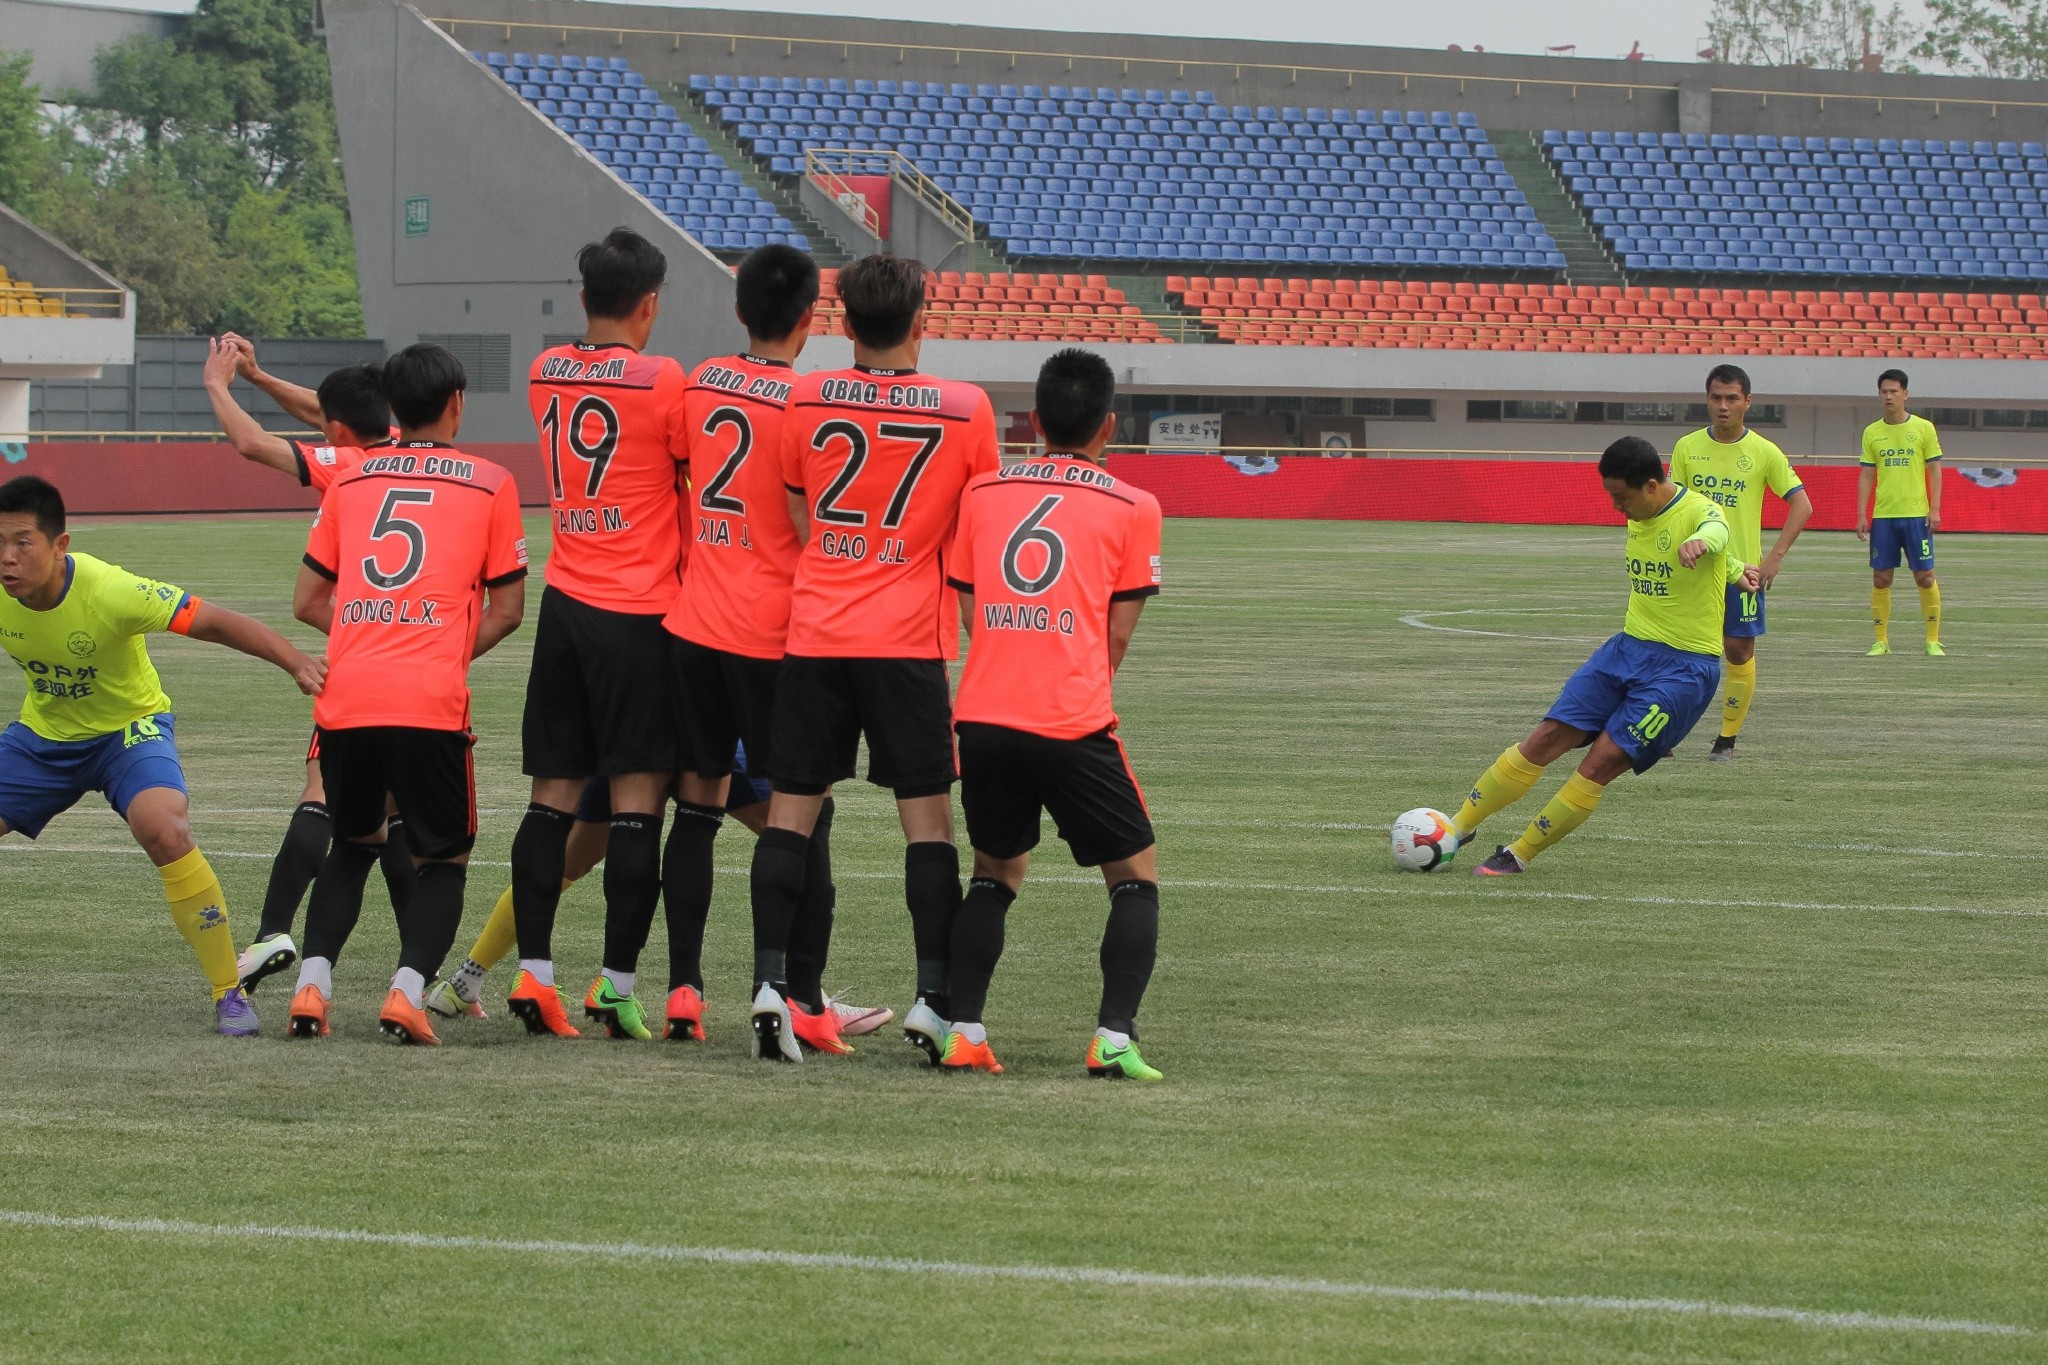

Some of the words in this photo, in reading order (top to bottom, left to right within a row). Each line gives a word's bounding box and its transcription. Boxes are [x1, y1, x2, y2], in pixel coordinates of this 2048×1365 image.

[541, 357, 626, 380] QBAO.COM
[746, 356, 766, 364] QBAO
[698, 365, 793, 403] QBAO.COM
[821, 378, 940, 409] QBAO.COM
[1159, 422, 1200, 435] 安检处
[542, 394, 619, 500] 19
[701, 405, 753, 517] 2
[362, 456, 474, 480] QBAO.COM
[811, 419, 944, 529] 27
[998, 462, 1115, 489] QBAO.COM
[602, 506, 630, 532] M.
[697, 517, 731, 546] XIA
[740, 524, 753, 550] J.
[362, 488, 434, 591] 5
[822, 531, 867, 561] GAO
[878, 538, 910, 564] J.L.
[1001, 494, 1064, 597] 6
[1921, 539, 1930, 556] 5
[399, 600, 441, 625] L.X.
[984, 604, 1074, 635] WANG.Q
[1740, 592, 1757, 617] 16
[1636, 704, 1670, 739] 10
[124, 735, 163, 749] KELME
